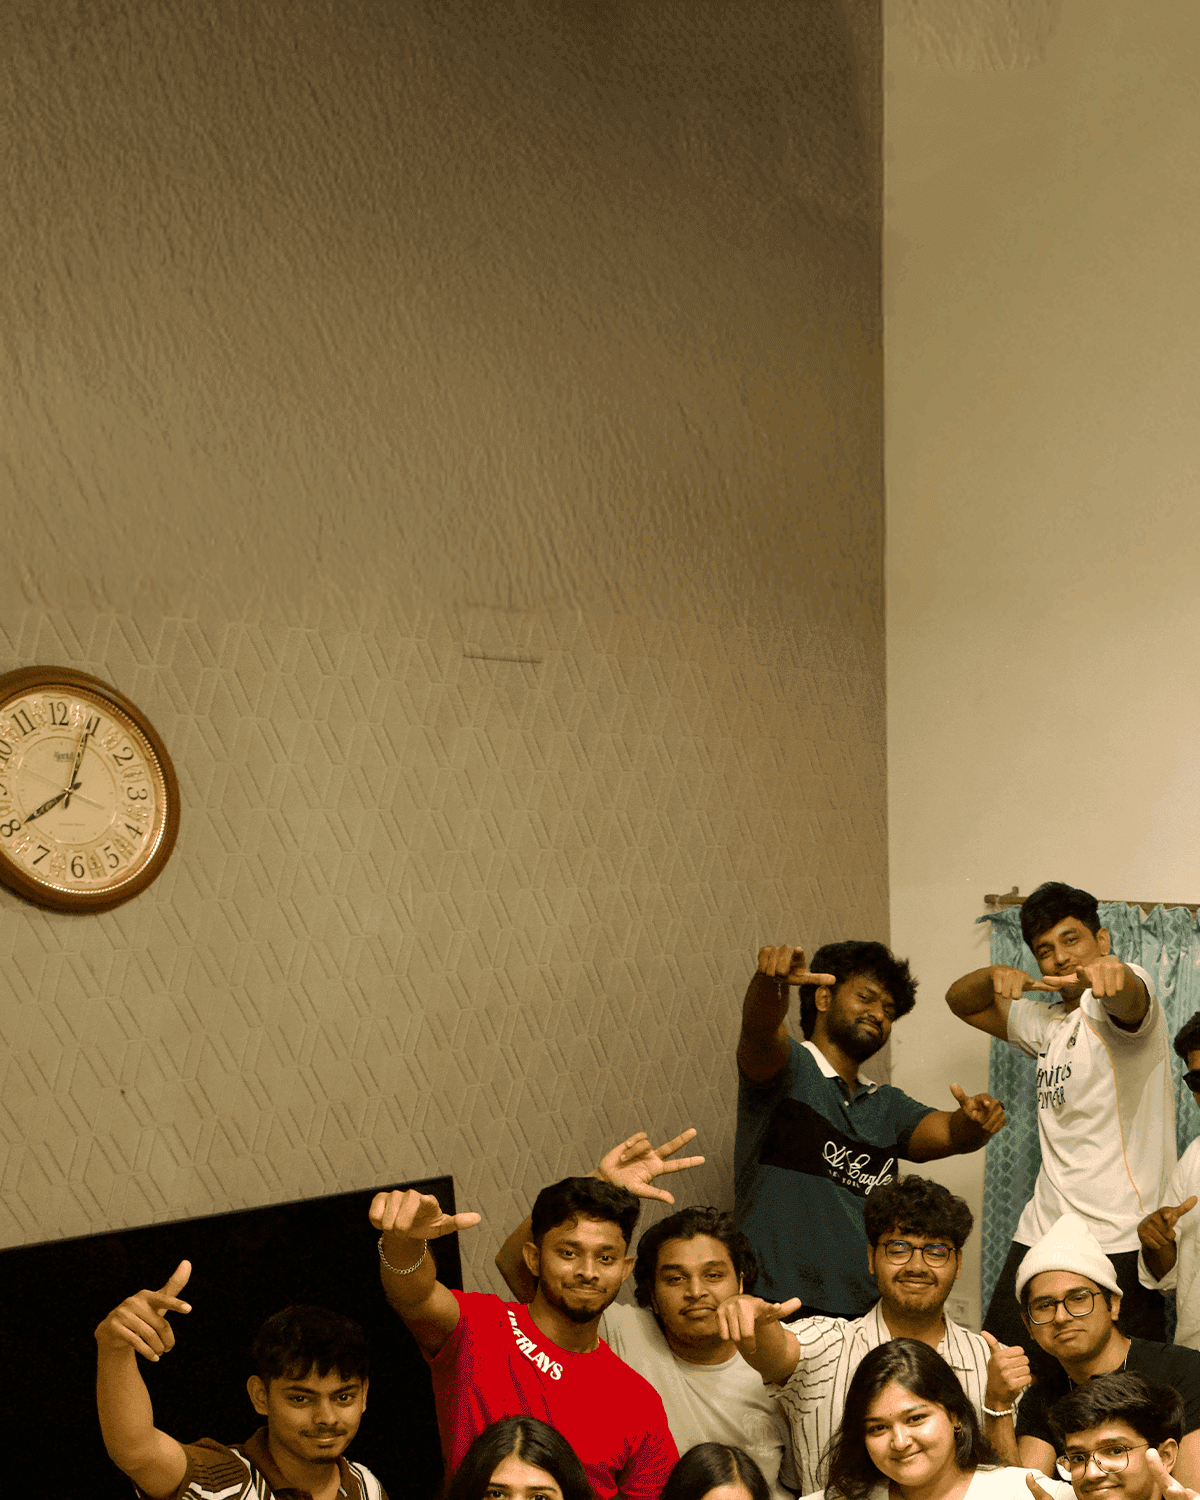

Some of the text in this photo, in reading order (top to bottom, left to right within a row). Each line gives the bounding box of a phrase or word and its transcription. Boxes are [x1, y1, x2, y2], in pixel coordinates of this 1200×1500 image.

[11, 709, 37, 736] 11
[49, 702, 69, 726] 12
[112, 747, 134, 766] 2
[127, 786, 148, 801] 3
[0, 818, 22, 838] 8
[124, 822, 144, 839] 4
[32, 844, 51, 866] 7
[103, 845, 120, 869] 5
[70, 855, 85, 879] 6
